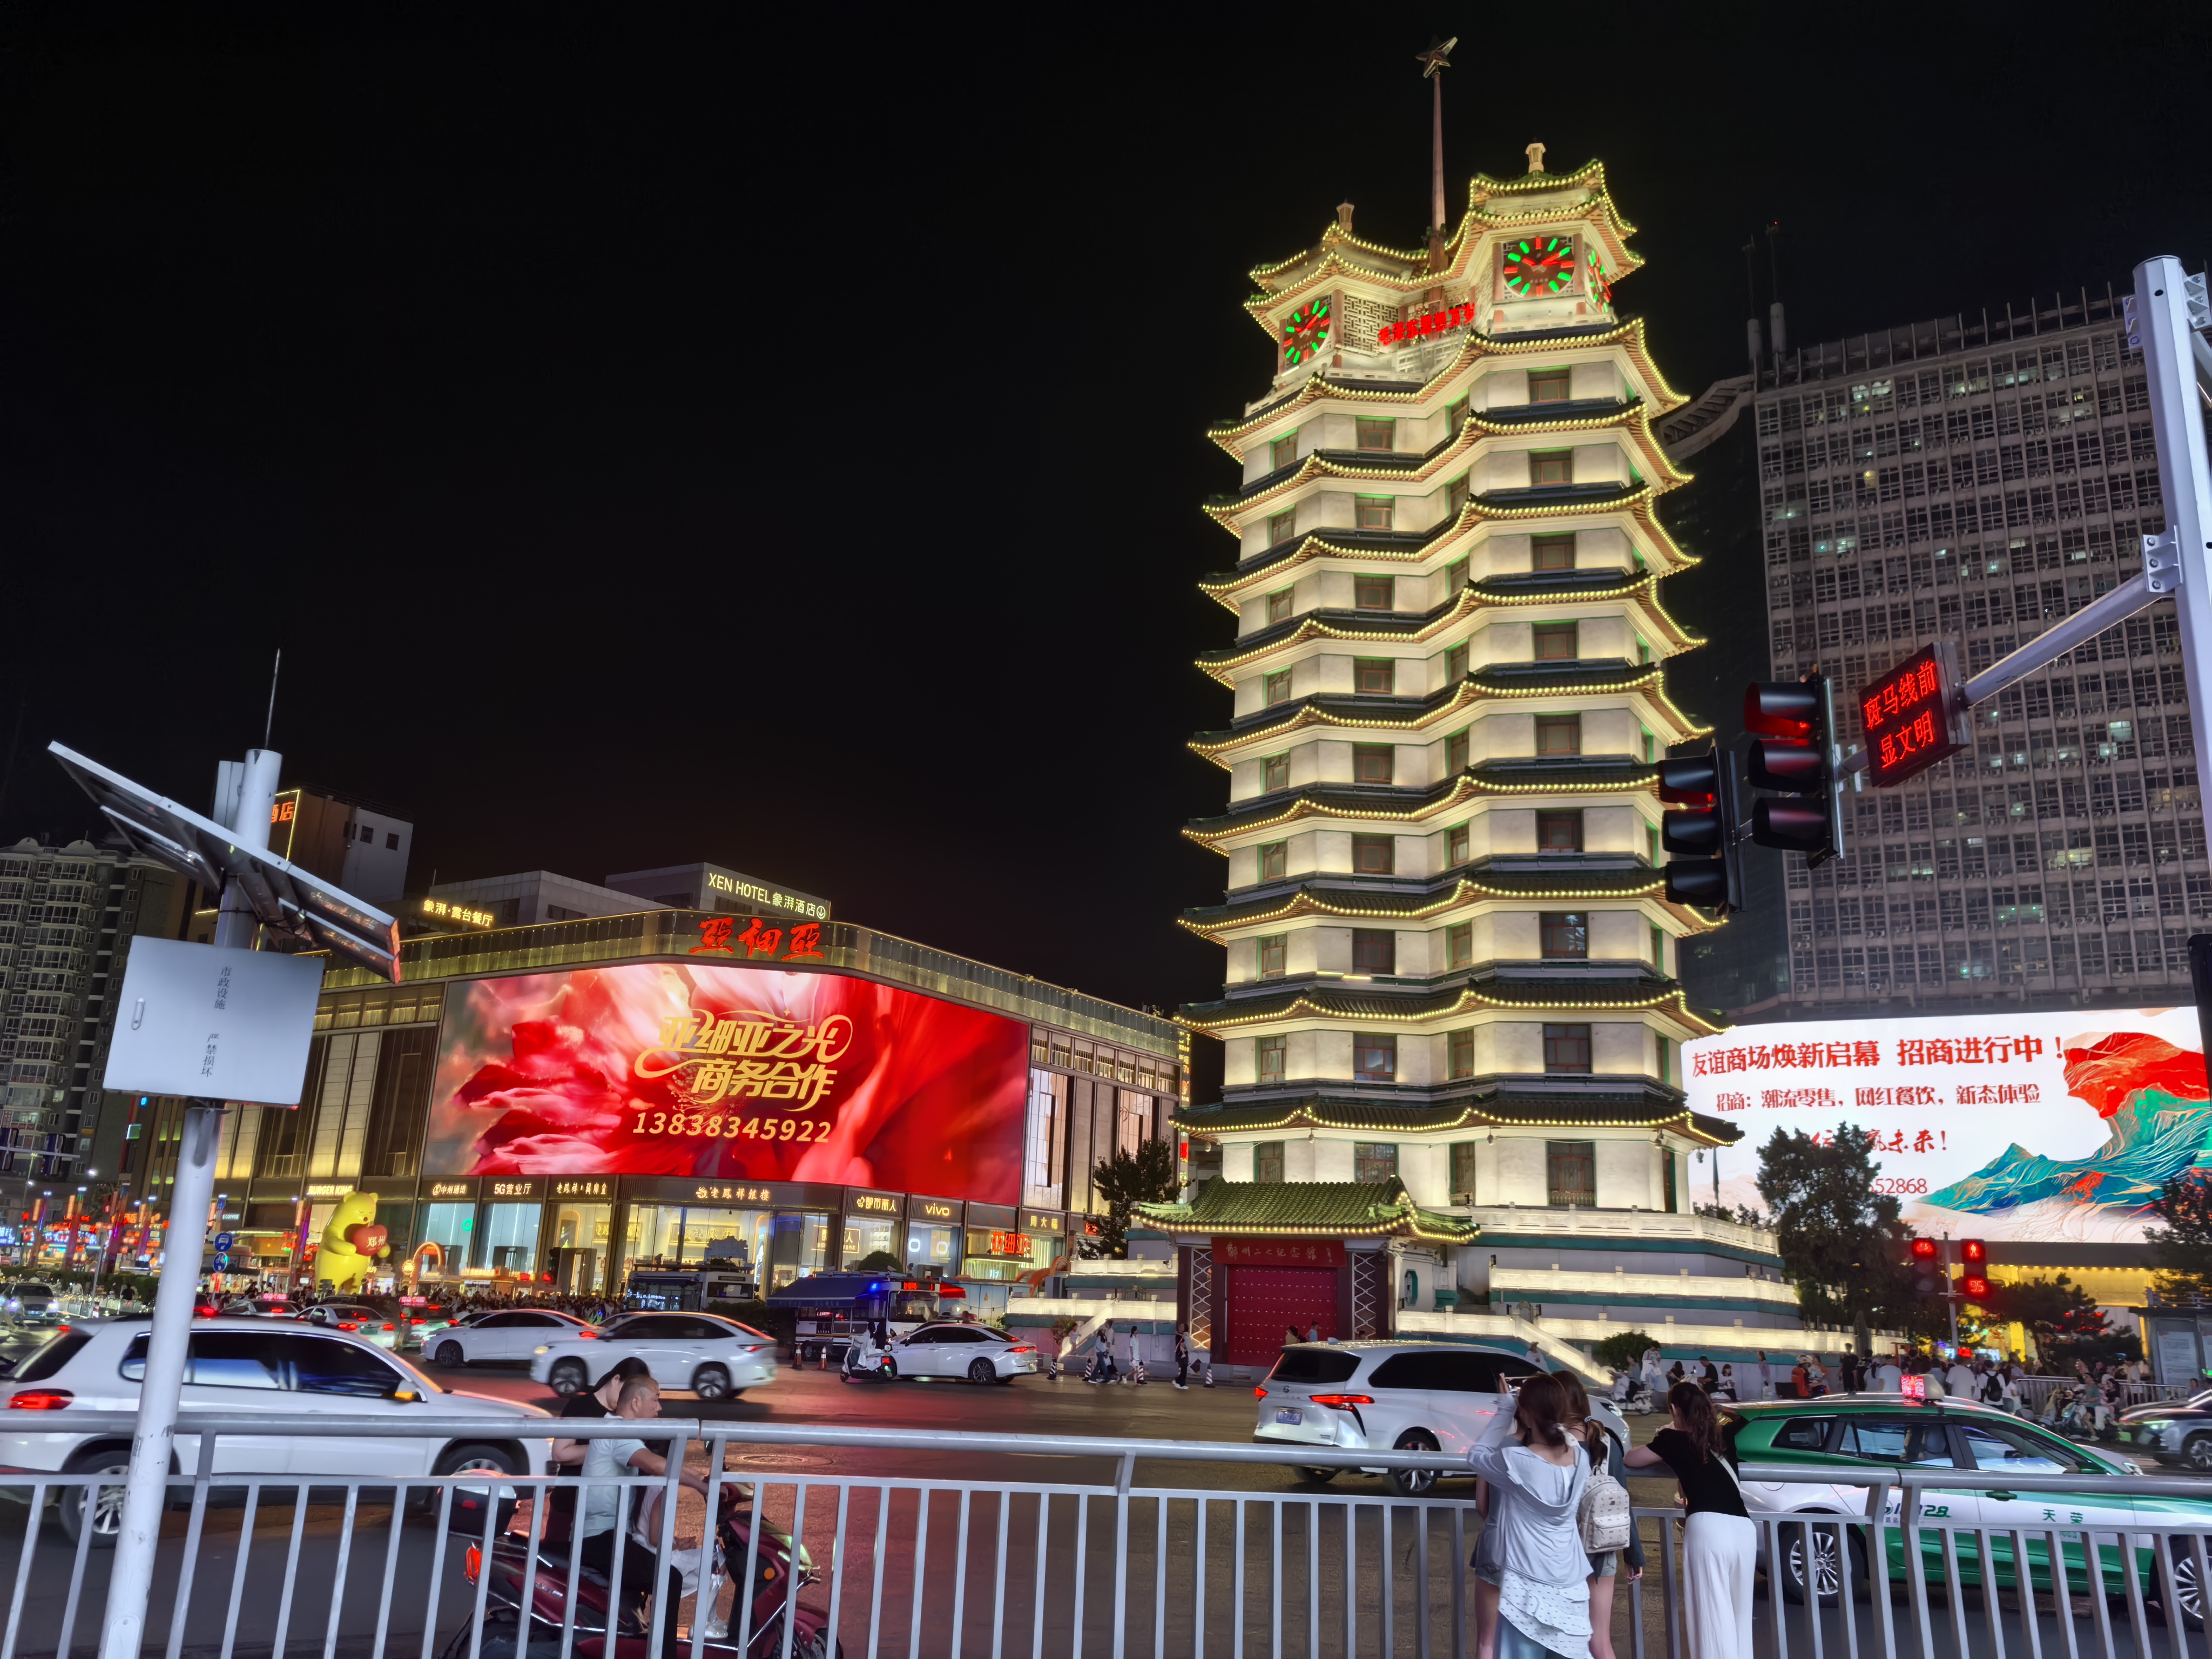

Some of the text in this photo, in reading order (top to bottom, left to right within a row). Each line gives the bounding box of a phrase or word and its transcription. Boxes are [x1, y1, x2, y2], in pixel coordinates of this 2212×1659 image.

[1864, 659, 1936, 730] 斑马线前
[1880, 710, 1934, 768] 显文明
[709, 872, 733, 892] XEN
[736, 881, 771, 904] HOTEL
[214, 966, 232, 1010] 市政设施
[658, 1009, 853, 1063] 亚细亚之光
[200, 1033, 219, 1078] 严禁损坏
[1692, 1040, 1880, 1077] 友谊商场焕新启幕
[686, 1058, 838, 1111] 商务合作
[632, 1112, 831, 1143] 13838345922
[308, 1185, 354, 1196] BURGER KING
[494, 1183, 532, 1195] 5G营业厅
[865, 1197, 896, 1212] 都市丽人
[925, 1203, 950, 1216] vivo
[1030, 1216, 1058, 1230] 周大福
[366, 1235, 386, 1248] 郑州
[991, 1231, 1031, 1255] 亚细亚
[1970, 1280, 1984, 1292] 95
[1894, 1503, 1949, 1518] 128
